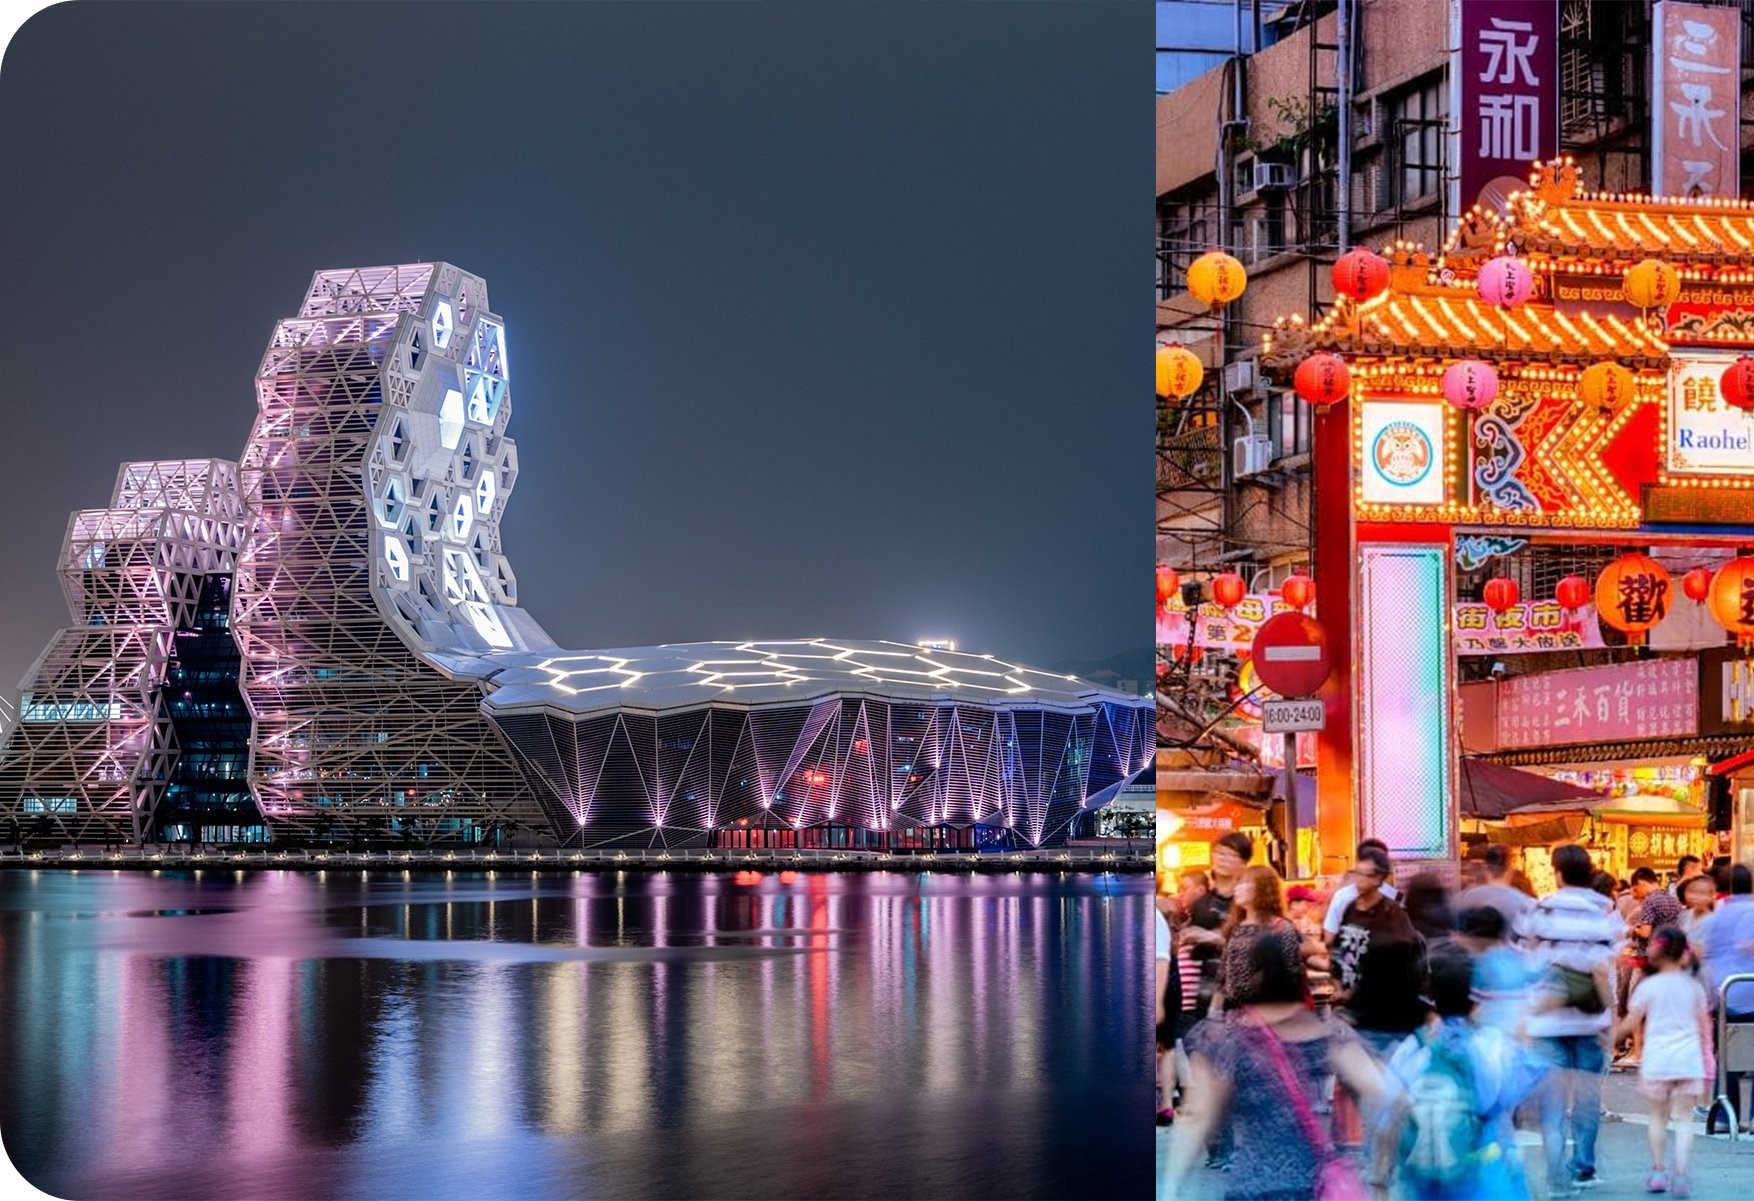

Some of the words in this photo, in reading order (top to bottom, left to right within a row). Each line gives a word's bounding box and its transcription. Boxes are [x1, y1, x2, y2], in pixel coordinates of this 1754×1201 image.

[1478, 16, 1540, 161] 永和
[1679, 427, 1748, 451] Raohe
[1265, 706, 1321, 724] 16:00-24:00
[1553, 678, 1634, 728] 三禾百貨
